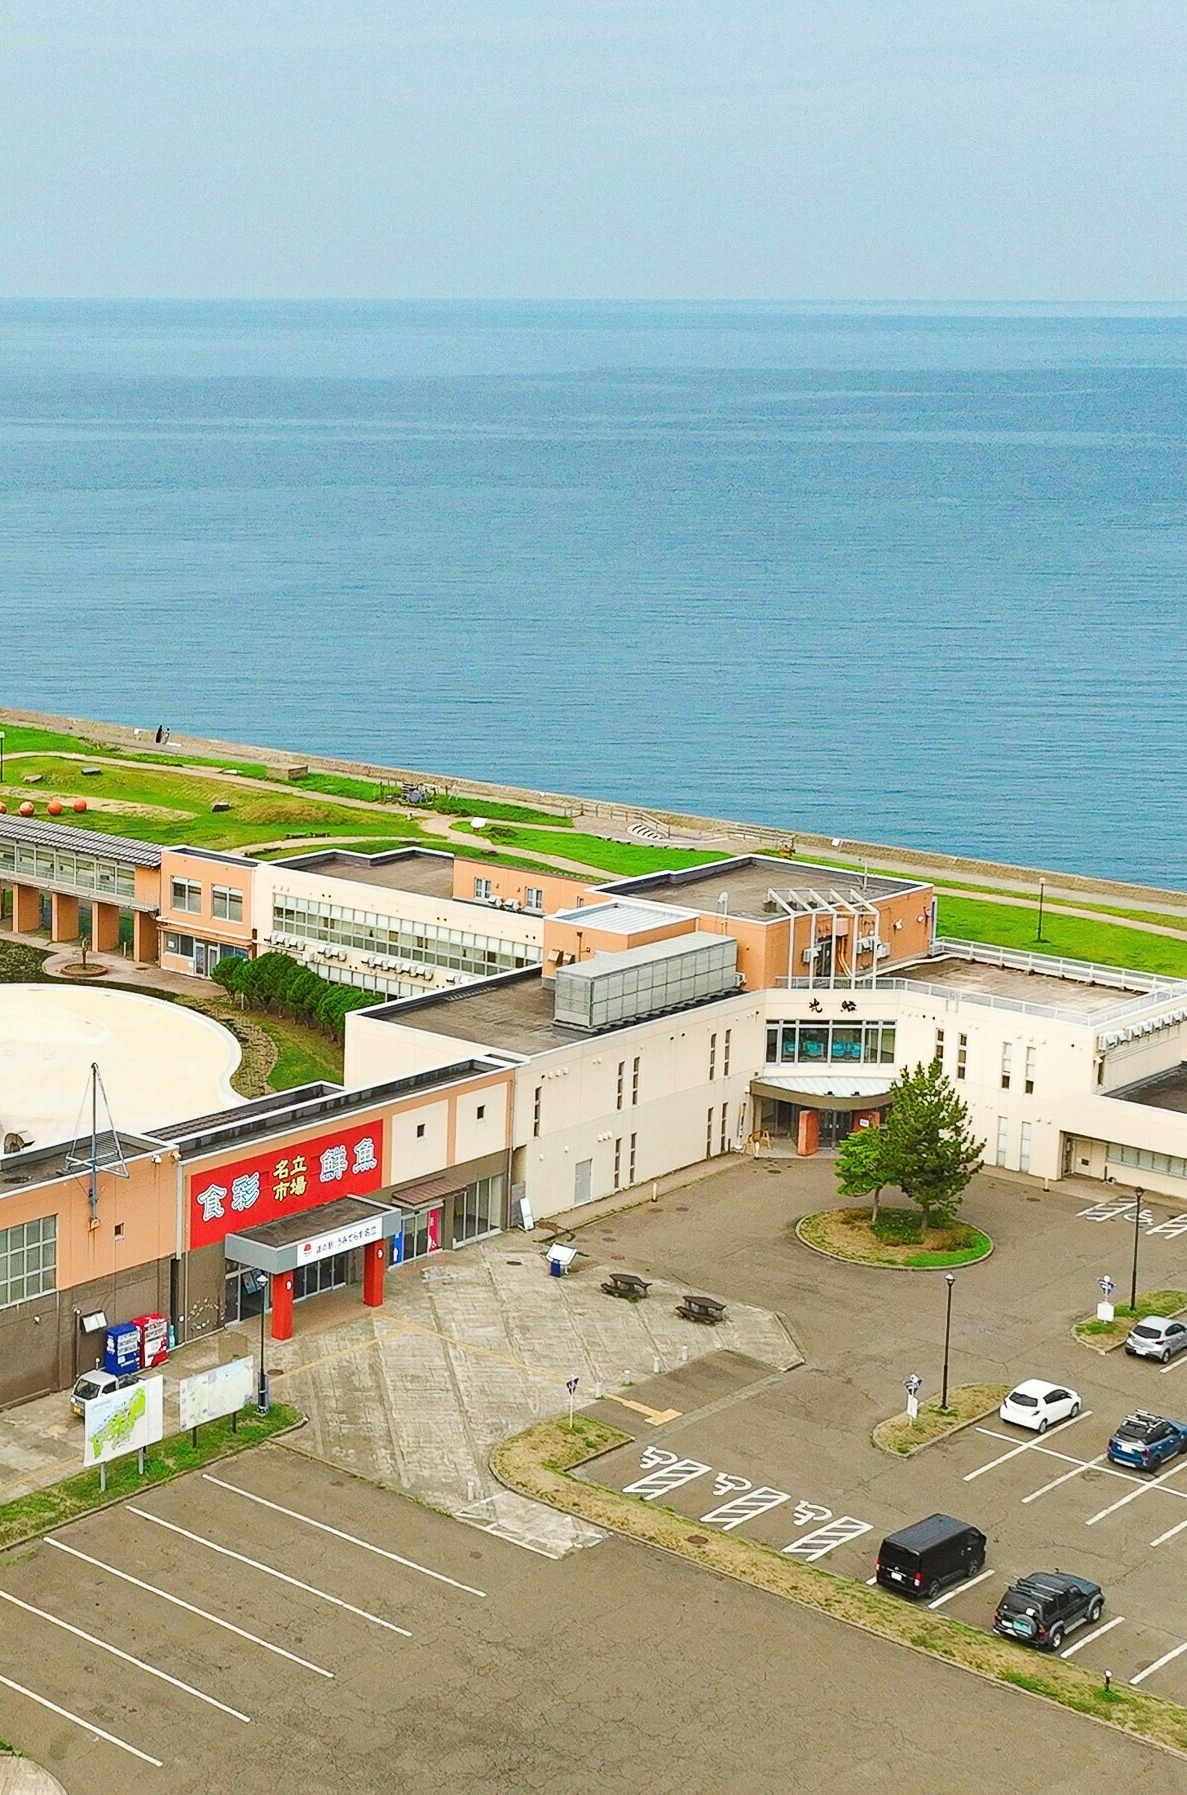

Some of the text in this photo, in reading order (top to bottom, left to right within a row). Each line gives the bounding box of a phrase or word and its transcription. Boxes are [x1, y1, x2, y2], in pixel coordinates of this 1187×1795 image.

[273, 1155, 308, 1180] 名立
[319, 1138, 378, 1183] 鮮魚
[197, 1171, 261, 1222] 食彩
[273, 1176, 308, 1202] 市場
